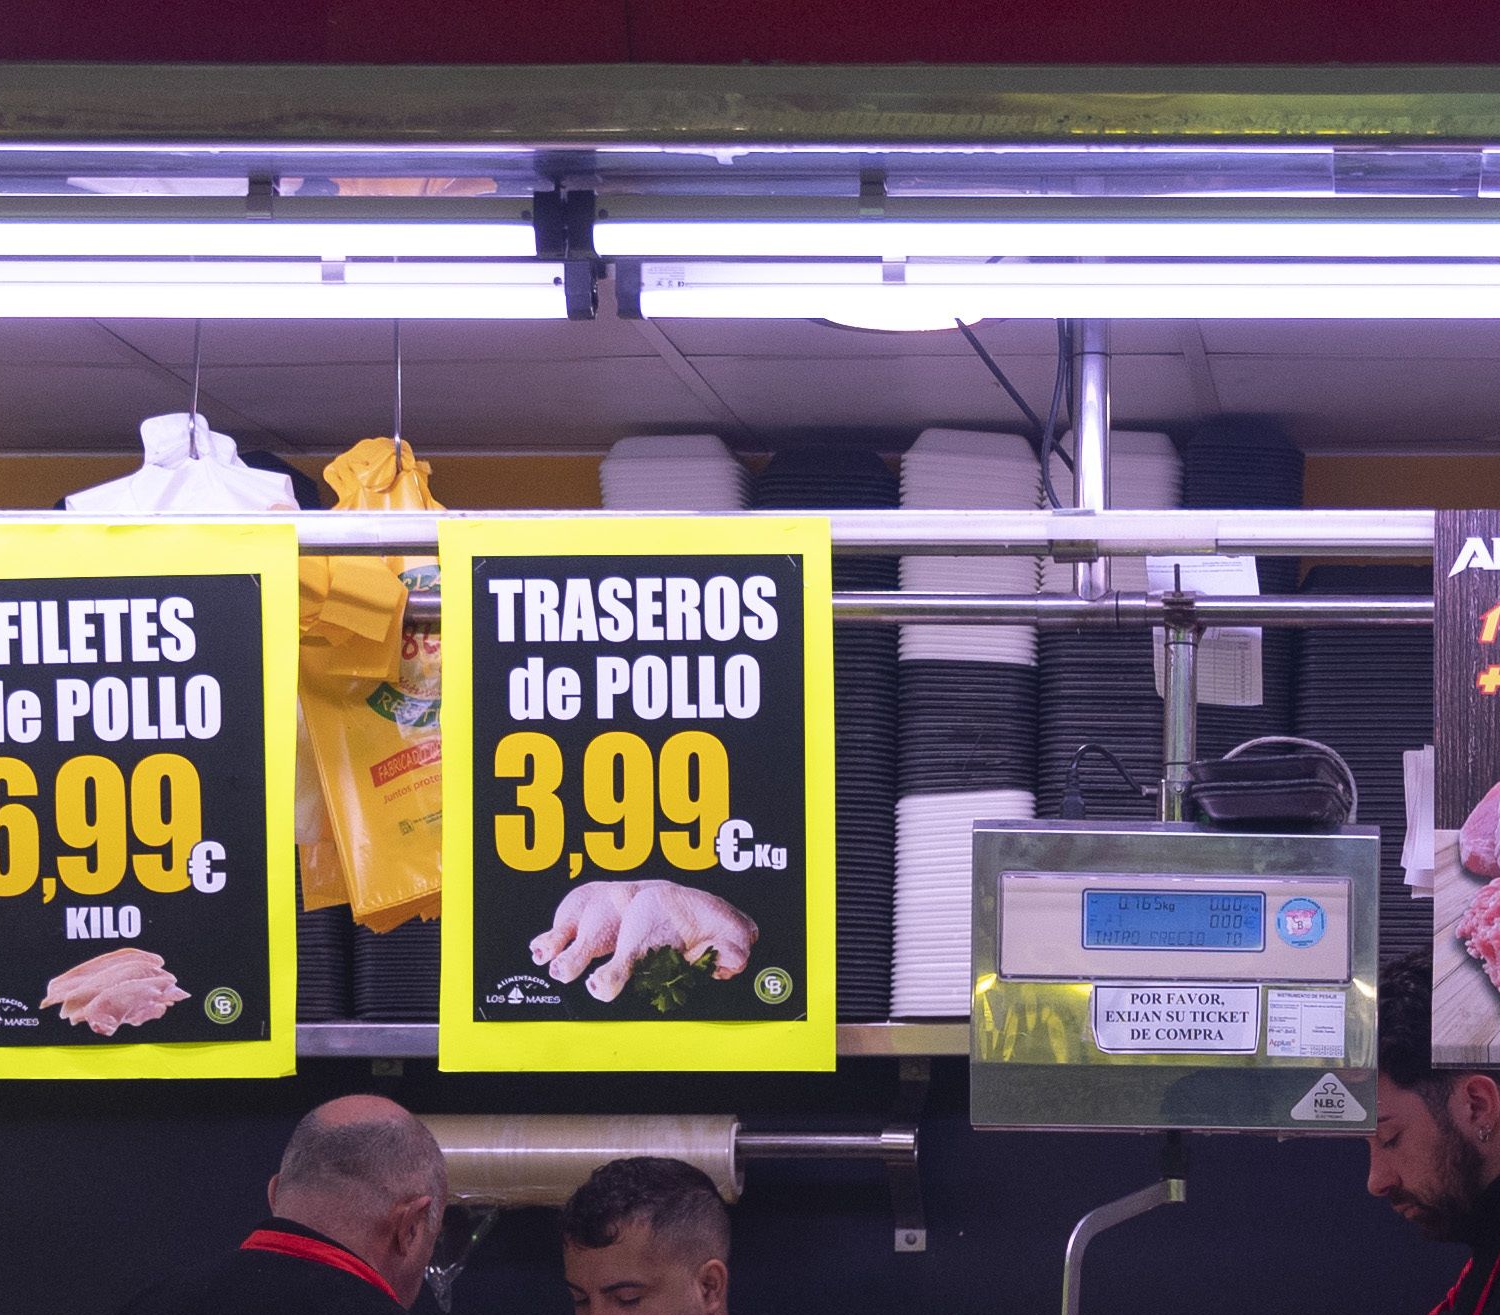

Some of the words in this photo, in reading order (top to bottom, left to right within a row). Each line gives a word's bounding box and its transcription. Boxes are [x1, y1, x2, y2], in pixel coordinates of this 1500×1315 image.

[489, 576, 778, 643] TRASEROS
[56, 674, 222, 742] POLLO
[508, 658, 581, 720] de
[596, 654, 761, 720] POLLO
[66, 906, 142, 940] KILO
